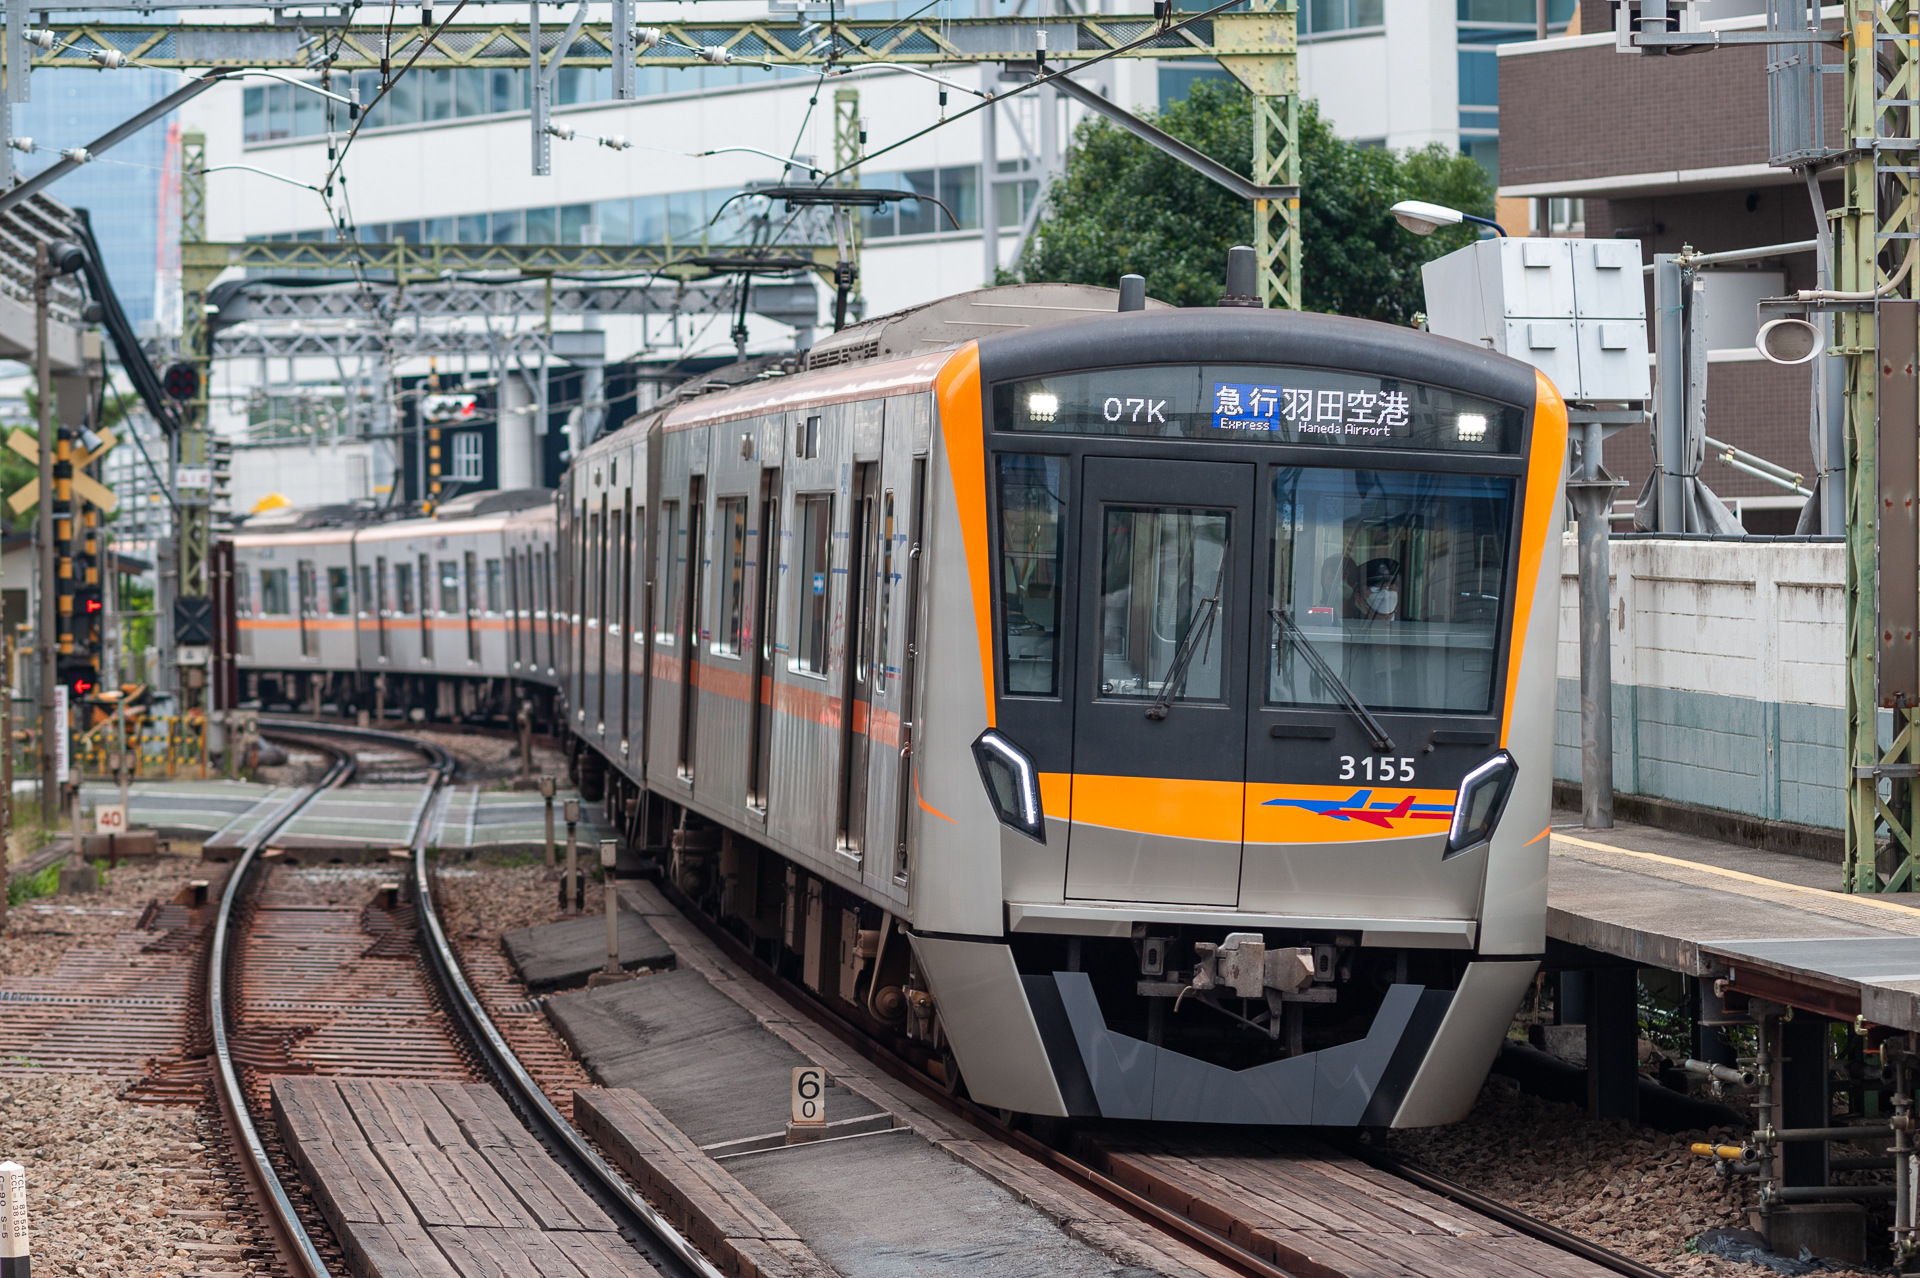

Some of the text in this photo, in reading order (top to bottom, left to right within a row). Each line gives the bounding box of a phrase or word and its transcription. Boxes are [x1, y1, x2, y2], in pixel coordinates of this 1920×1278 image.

[1104, 397, 1166, 423] 07K
[1215, 385, 1409, 426] 急行 羽田空港
[1220, 417, 1270, 431] Express
[1298, 421, 1391, 437] Haneda Airport
[1339, 755, 1415, 782] 3155
[100, 811, 122, 827] 40
[798, 1071, 820, 1100] 6
[802, 1100, 816, 1119] 0
